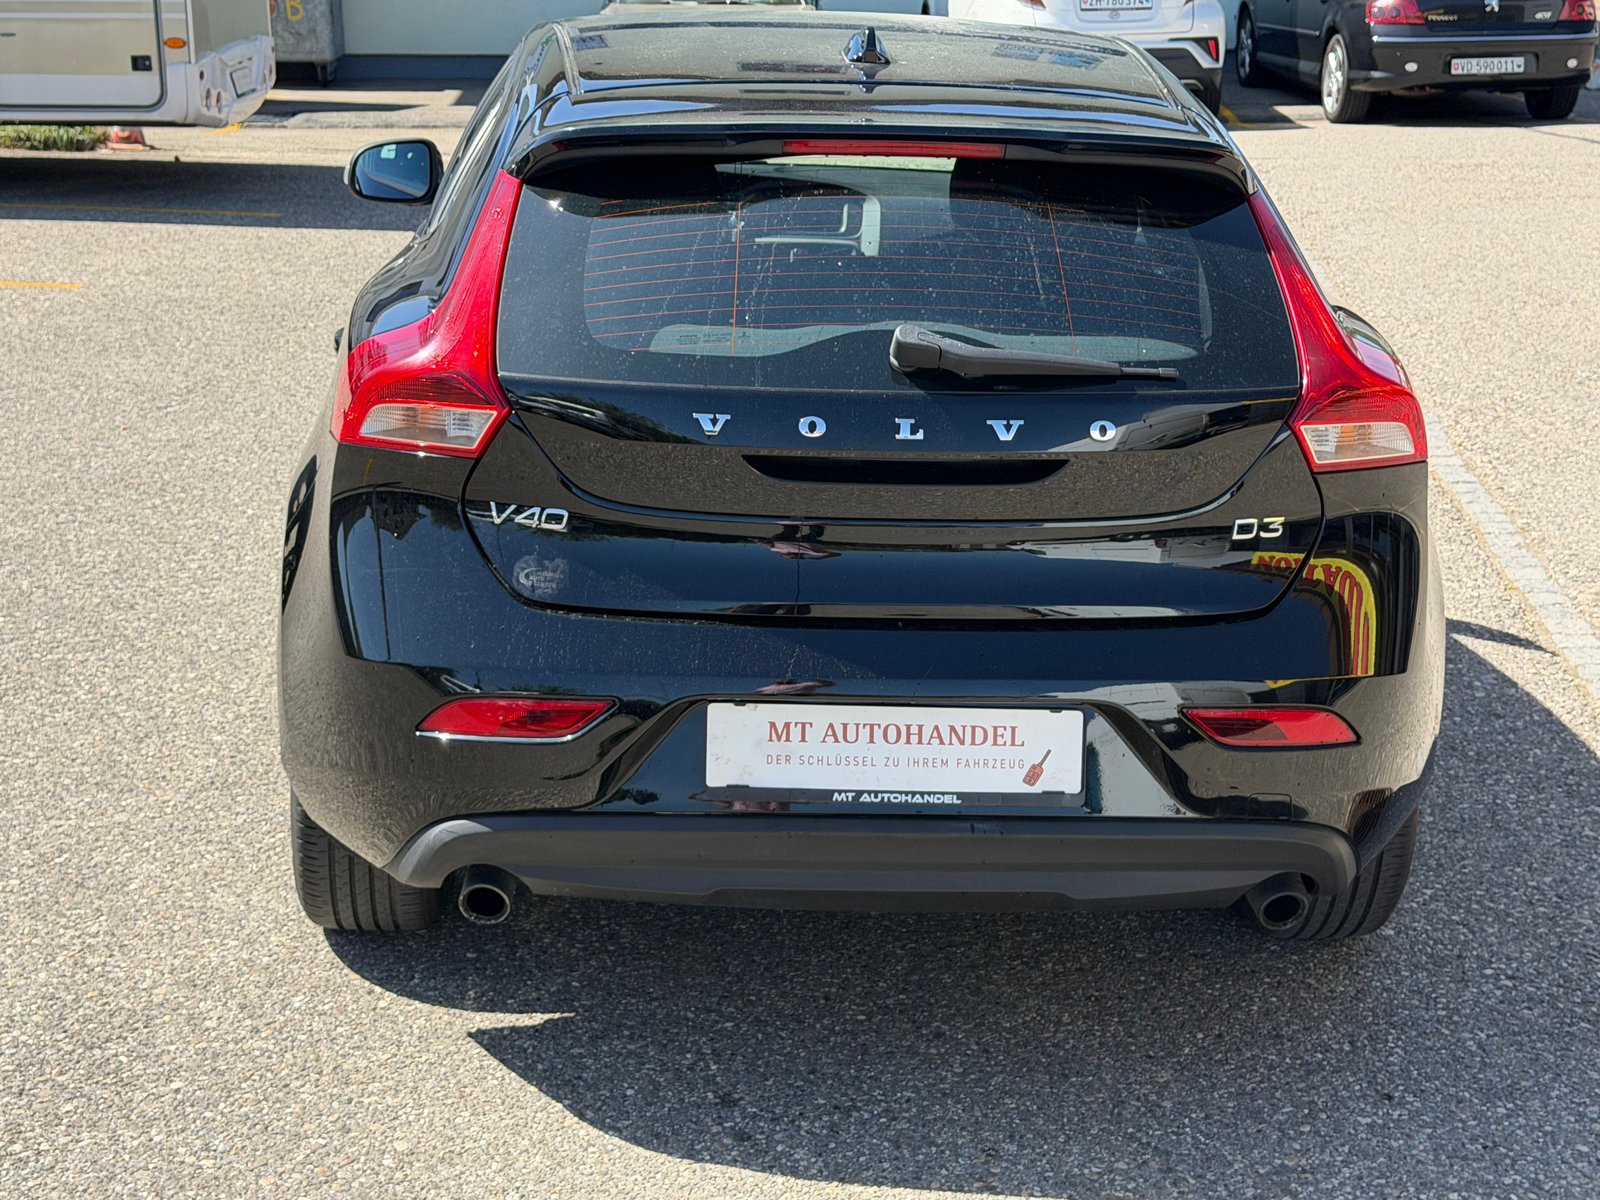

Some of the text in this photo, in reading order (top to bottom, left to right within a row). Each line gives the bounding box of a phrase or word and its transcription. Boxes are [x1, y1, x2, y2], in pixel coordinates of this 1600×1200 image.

[692, 412, 1117, 442] VOLVO
[489, 501, 569, 531] V40
[1231, 516, 1286, 540] D3
[767, 721, 1025, 747] MT AUTOHANDEL
[766, 753, 1025, 770] DER SCHLÜSSEL ZU IHREM FAHRZEUG
[832, 792, 962, 804] MT AUTOHANDEL
